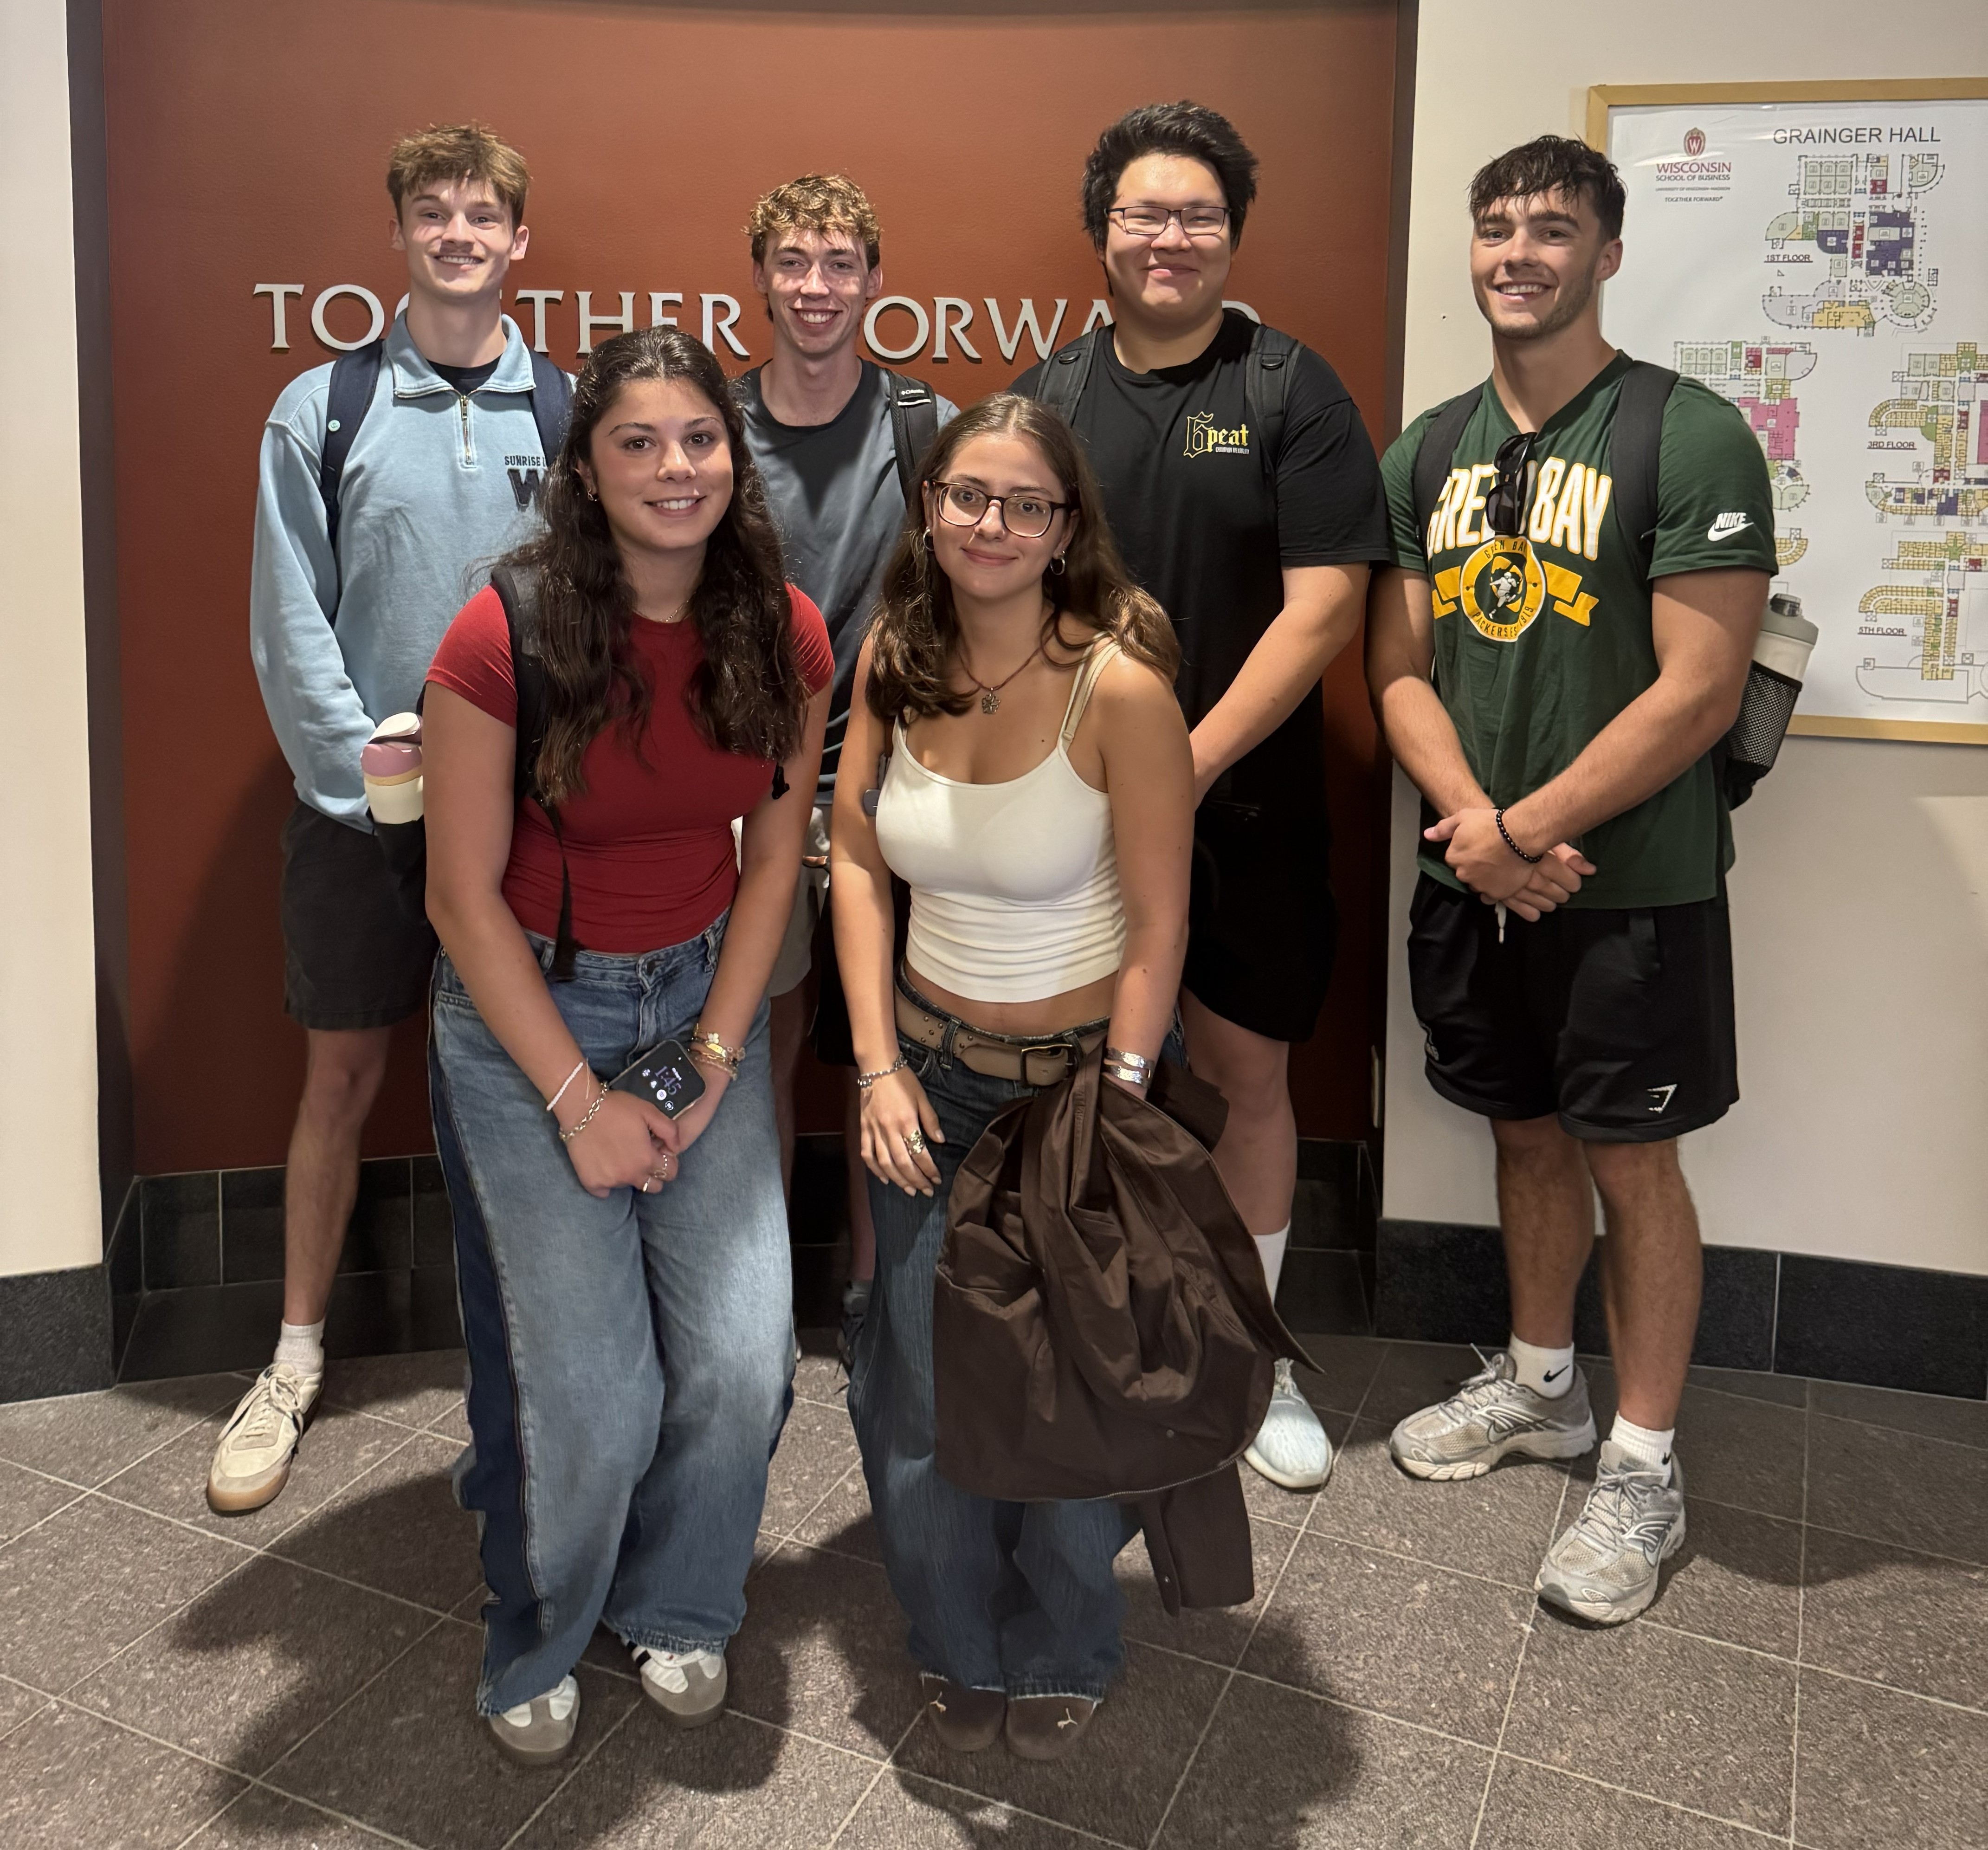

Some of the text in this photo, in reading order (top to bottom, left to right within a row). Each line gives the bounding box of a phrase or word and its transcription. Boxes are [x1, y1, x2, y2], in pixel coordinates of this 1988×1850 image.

[1773, 127, 1941, 144] GRAINGER HALL
[1657, 162, 1731, 173] WISCONSIN
[253, 284, 1261, 360] TOTHER ORWA
[504, 455, 541, 466] SUNRISE
[1529, 457, 1612, 561] BAY
[1715, 512, 1746, 529] NIKE
[1472, 612, 1508, 637] PACKERS
